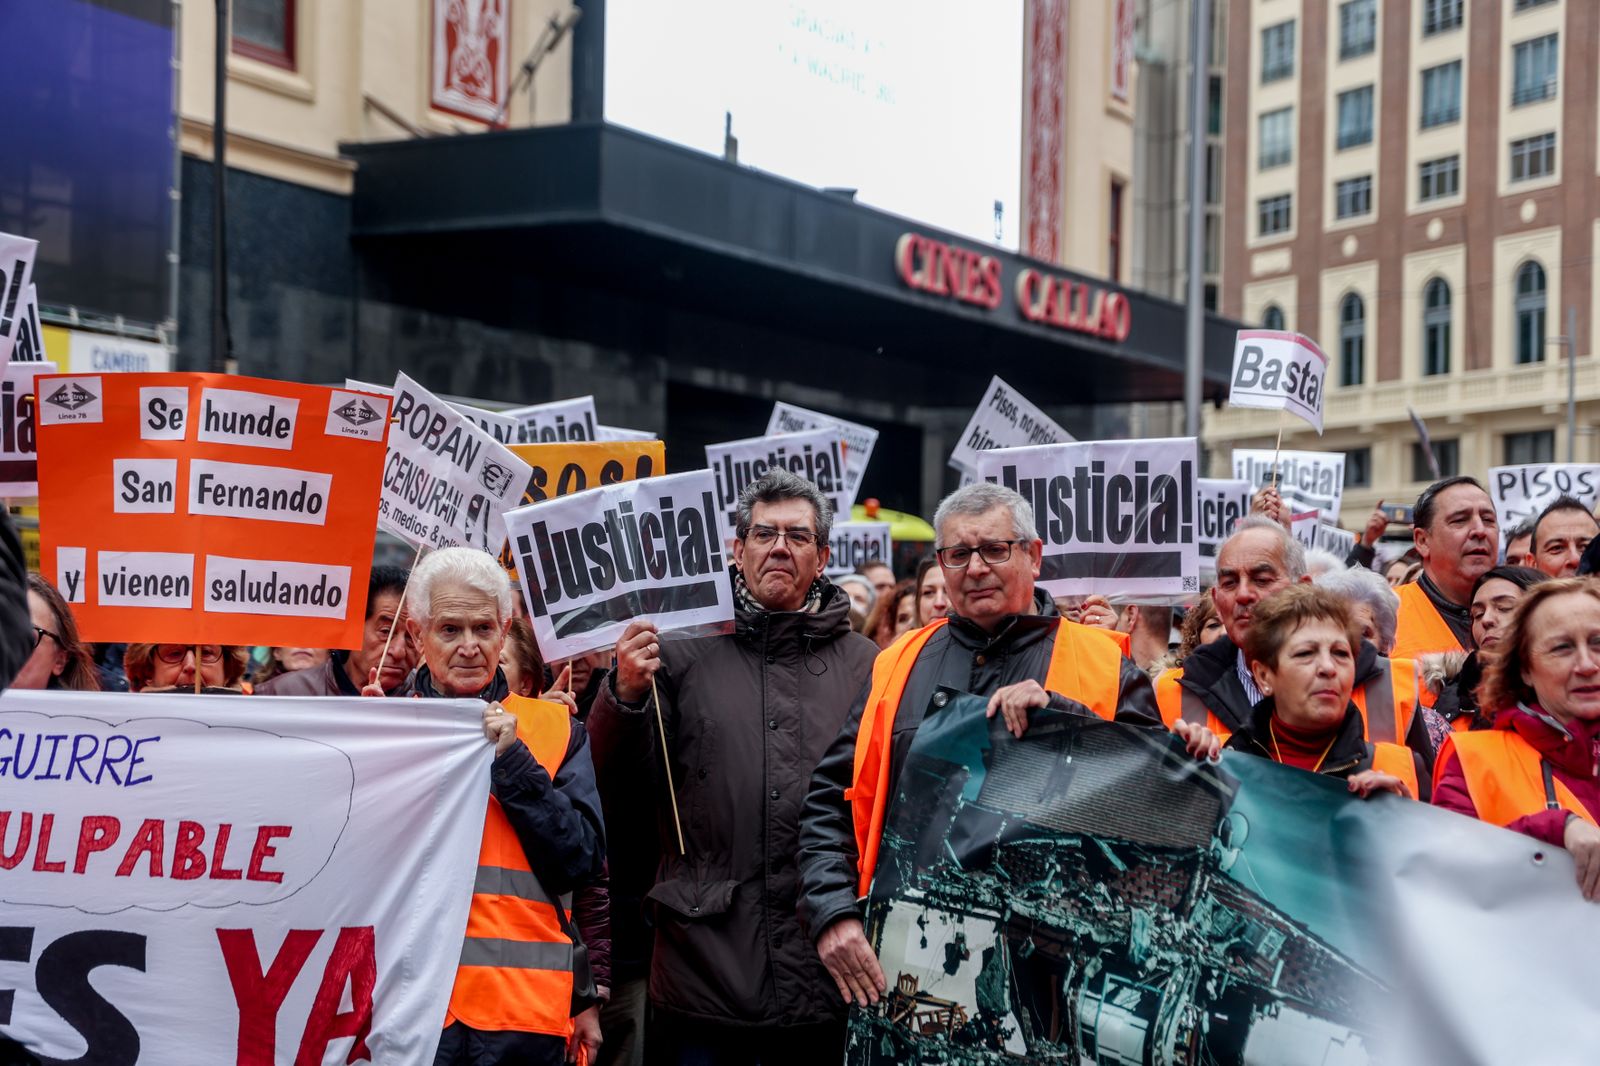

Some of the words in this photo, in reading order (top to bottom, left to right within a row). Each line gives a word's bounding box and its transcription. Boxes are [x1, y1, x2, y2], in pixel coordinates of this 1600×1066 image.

[895, 231, 1002, 310] CINES
[1015, 268, 1131, 342] CALLAO
[1233, 345, 1325, 412] Basta!
[148, 397, 184, 431] Se
[204, 399, 291, 439] hunde
[393, 390, 482, 474] ROBAN
[1019, 412, 1034, 434] no
[121, 470, 173, 504] San
[197, 473, 323, 515] Fernando
[391, 505, 429, 538] medios
[985, 460, 1193, 546] usticia!
[65, 570, 81, 602] y
[102, 566, 190, 597] vienen
[210, 569, 342, 608] saludando
[516, 490, 724, 617] ¡Justicia!
[215, 925, 377, 1066] YA
